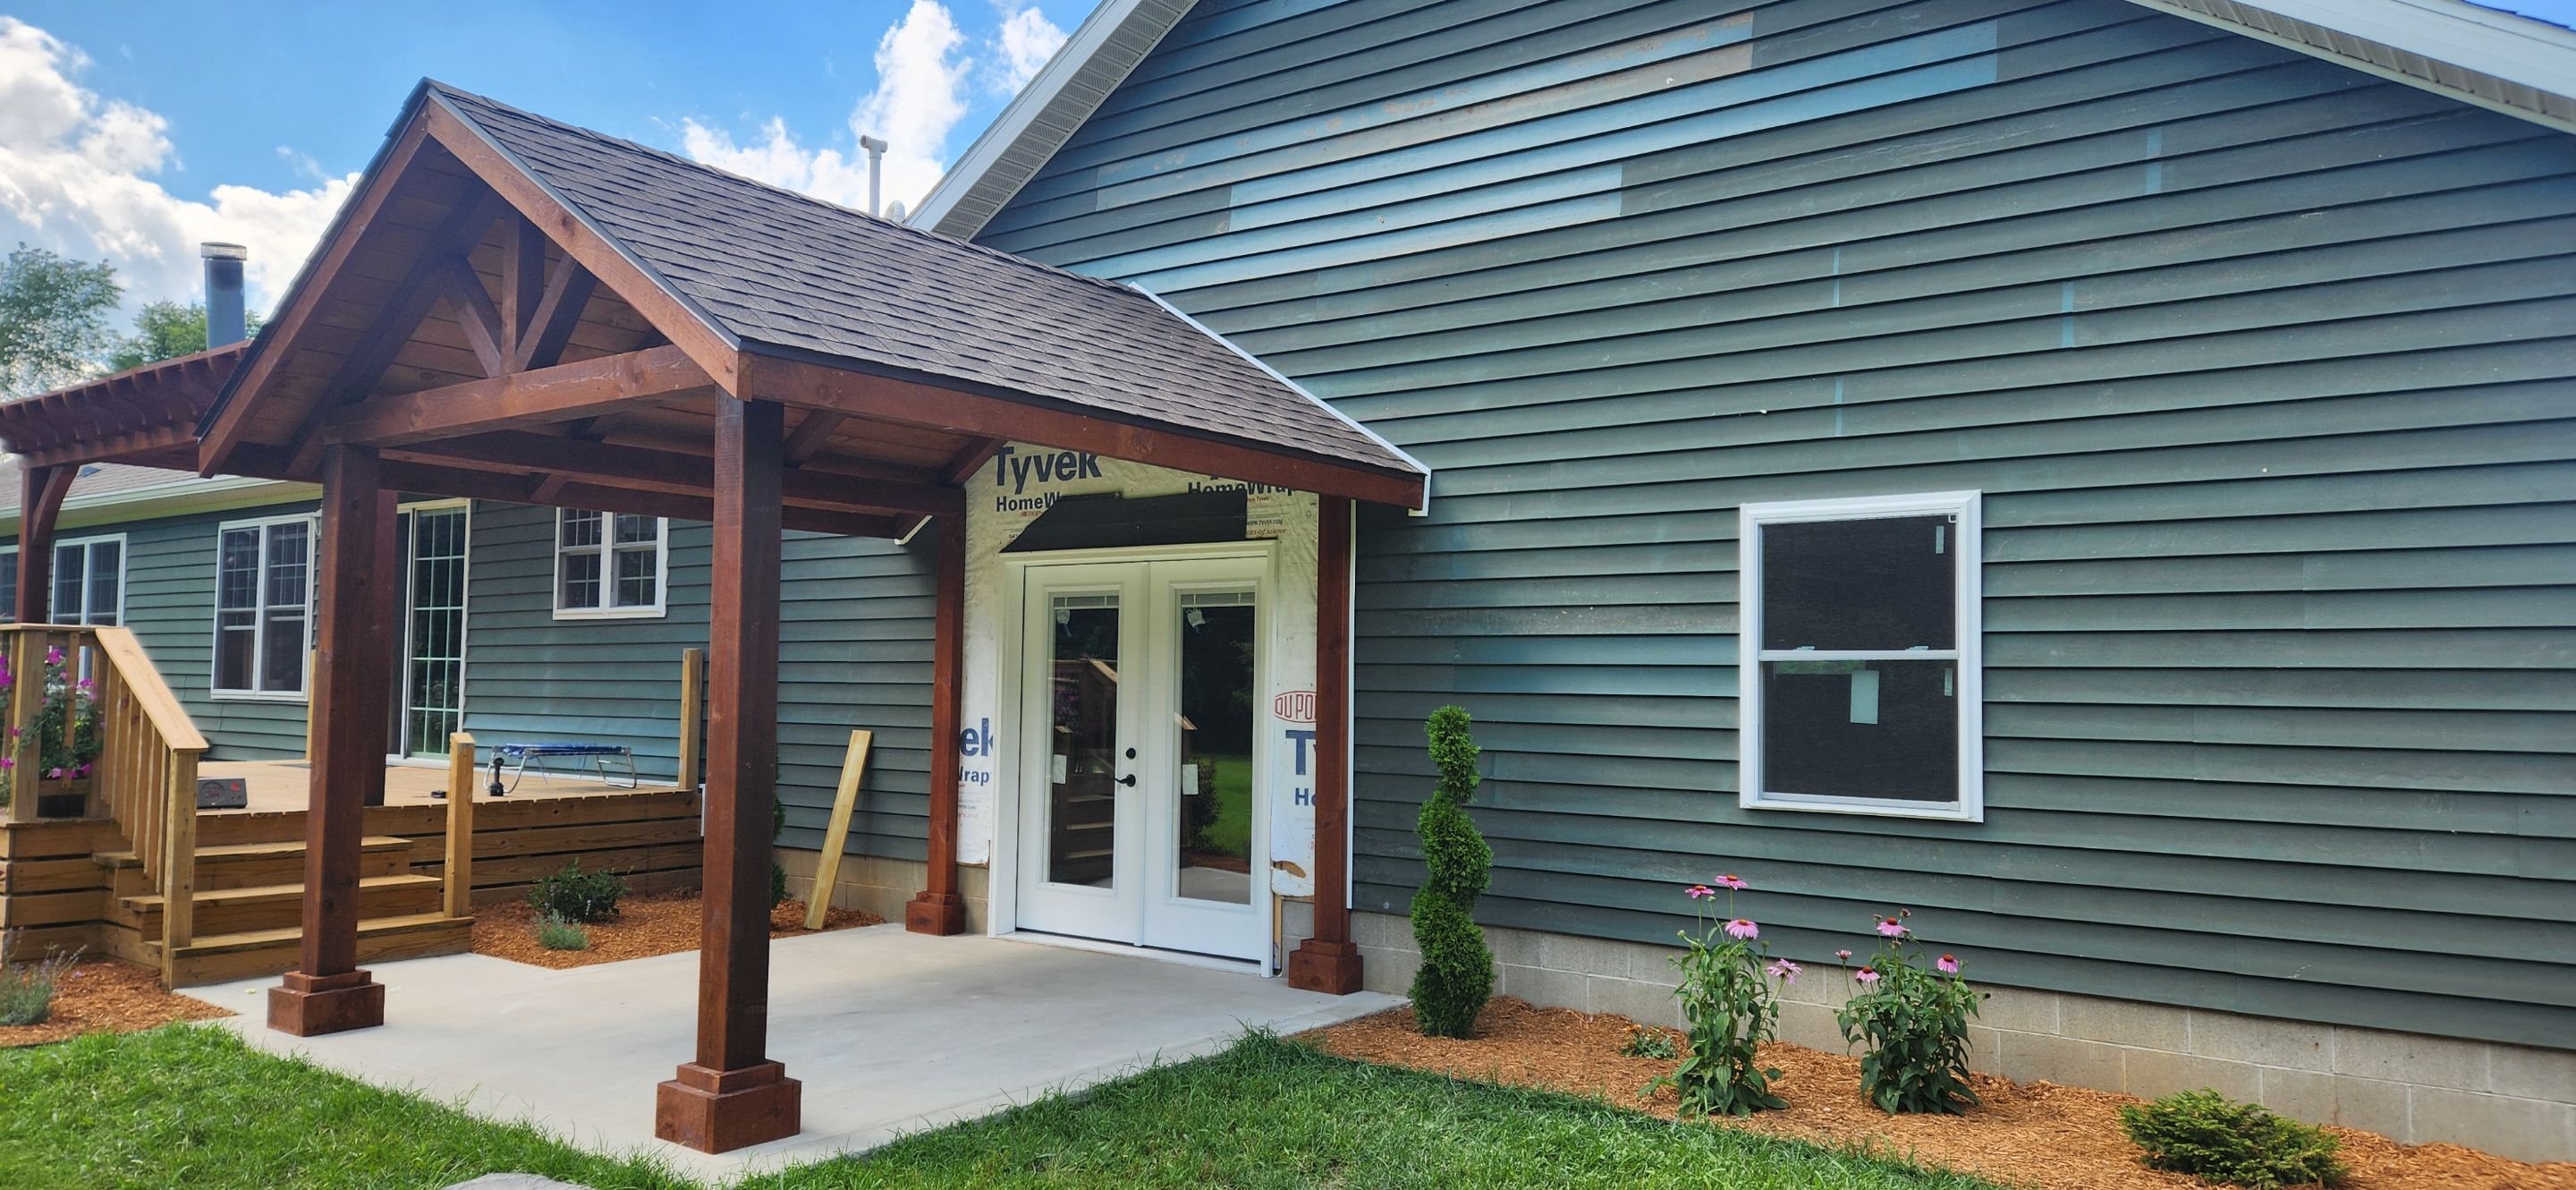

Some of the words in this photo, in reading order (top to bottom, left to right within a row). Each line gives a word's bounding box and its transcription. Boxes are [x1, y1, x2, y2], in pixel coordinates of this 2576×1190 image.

[997, 446, 1102, 495] Tyvek
[996, 491, 1061, 512] HomeW
[1275, 694, 1317, 719] DUPO
